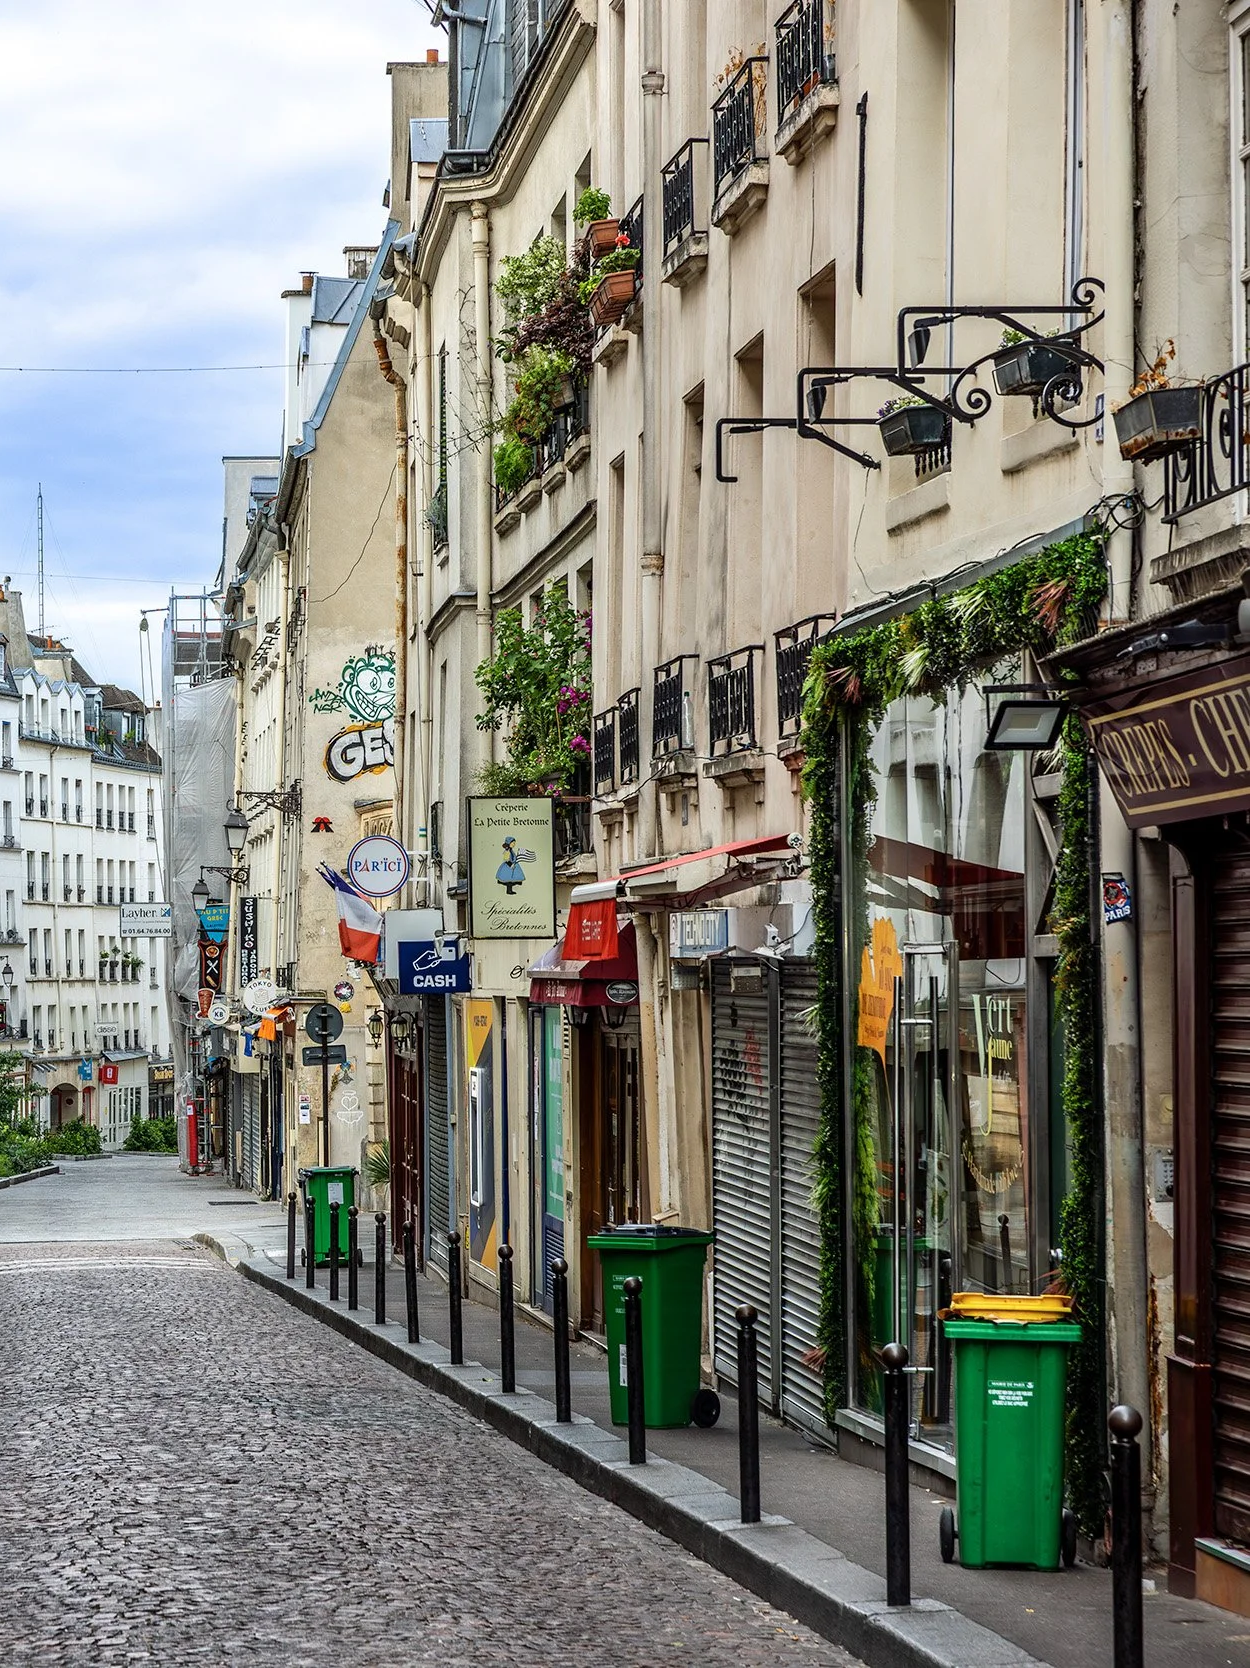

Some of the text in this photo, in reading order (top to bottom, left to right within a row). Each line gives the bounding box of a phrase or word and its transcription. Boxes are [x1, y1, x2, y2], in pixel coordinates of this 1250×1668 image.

[1190, 686, 1250, 778] CH
[495, 803, 529, 813] Crêperie
[474, 817, 549, 828] La Petite Bretonne
[480, 900, 537, 920] Spécialités
[244, 898, 255, 949] SUSHIKO
[490, 916, 548, 931] Bretonnes
[249, 981, 272, 991] TOKYO
[413, 974, 457, 988] CASH
[214, 1010, 224, 1018] KB
